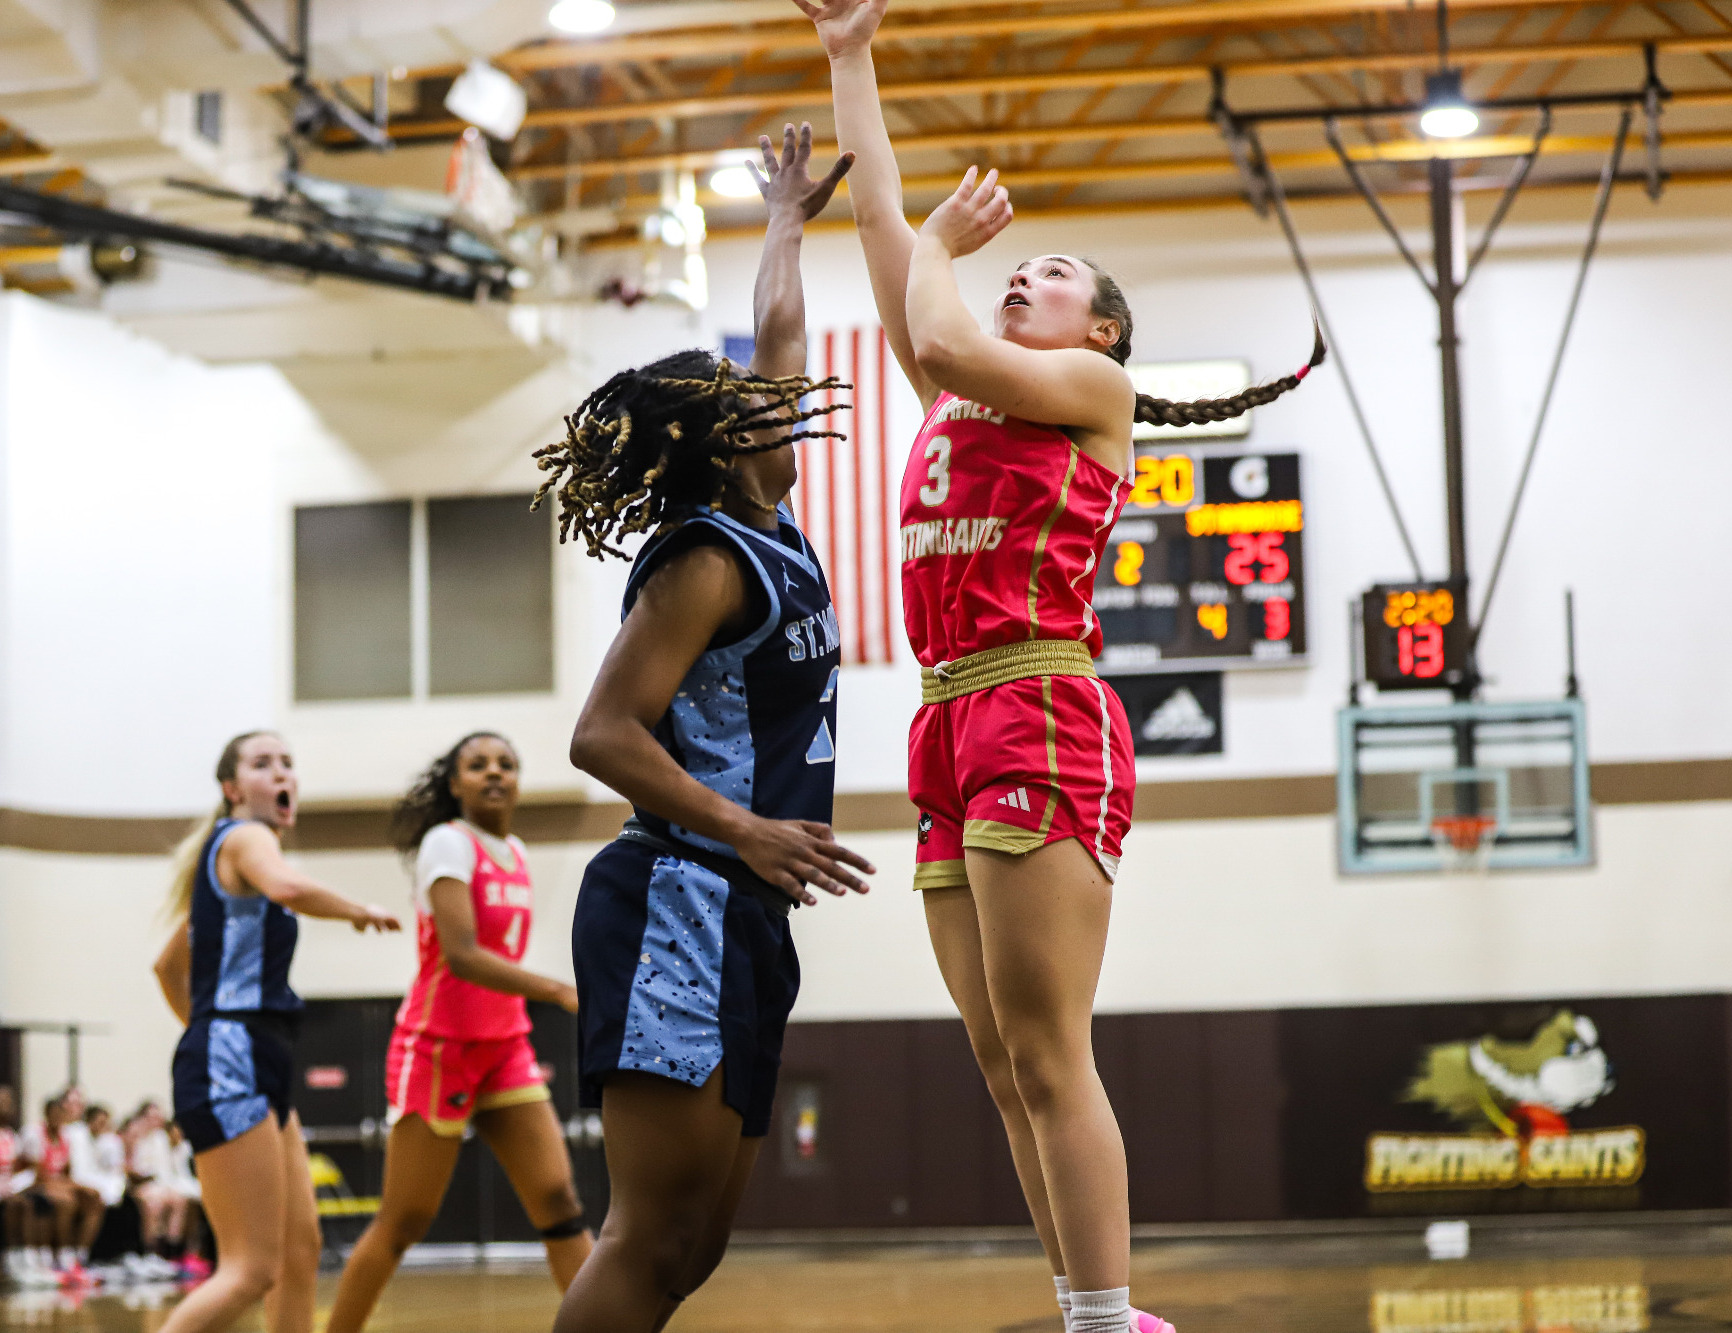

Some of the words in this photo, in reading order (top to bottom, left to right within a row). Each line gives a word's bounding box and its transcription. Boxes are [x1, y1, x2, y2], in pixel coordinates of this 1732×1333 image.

[919, 435, 951, 507] 3
[1224, 531, 1290, 585] 25
[1397, 621, 1445, 678] 13
[503, 911, 522, 956] 4
